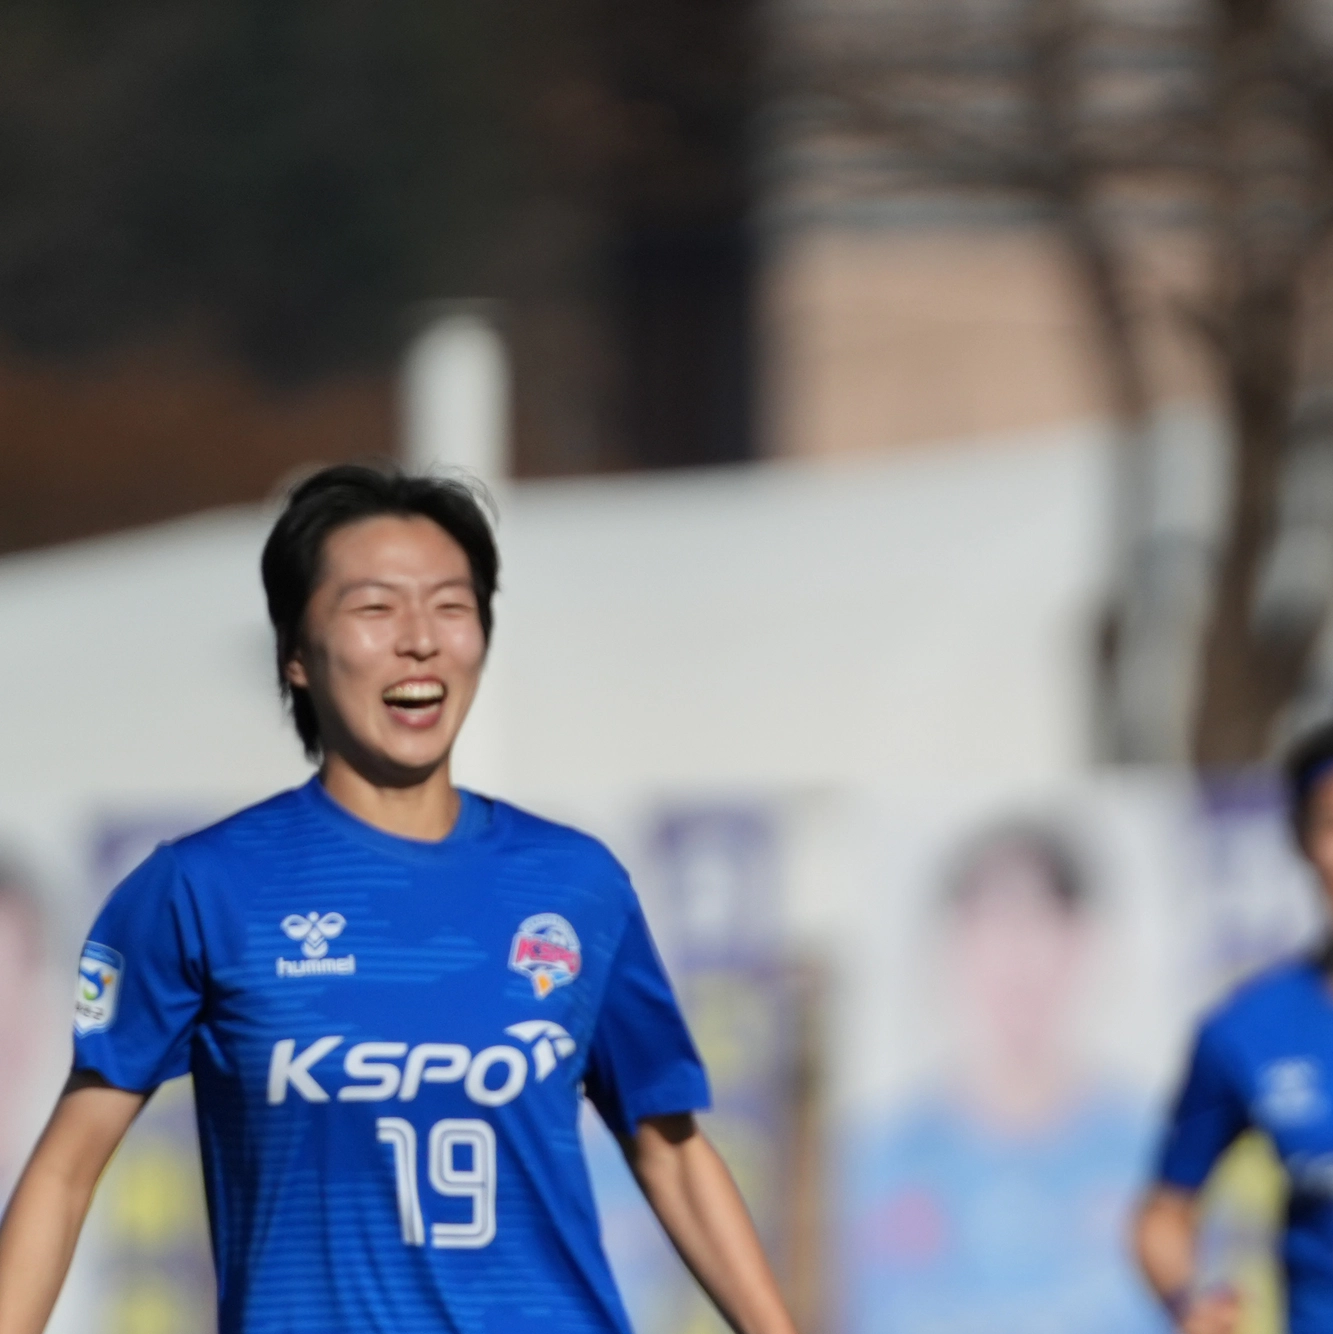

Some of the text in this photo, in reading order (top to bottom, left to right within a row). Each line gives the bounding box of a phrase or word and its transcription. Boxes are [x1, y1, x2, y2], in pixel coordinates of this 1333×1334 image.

[275, 954, 355, 978] hummel
[267, 1035, 528, 1107] KSPO
[376, 1117, 497, 1249] 19
